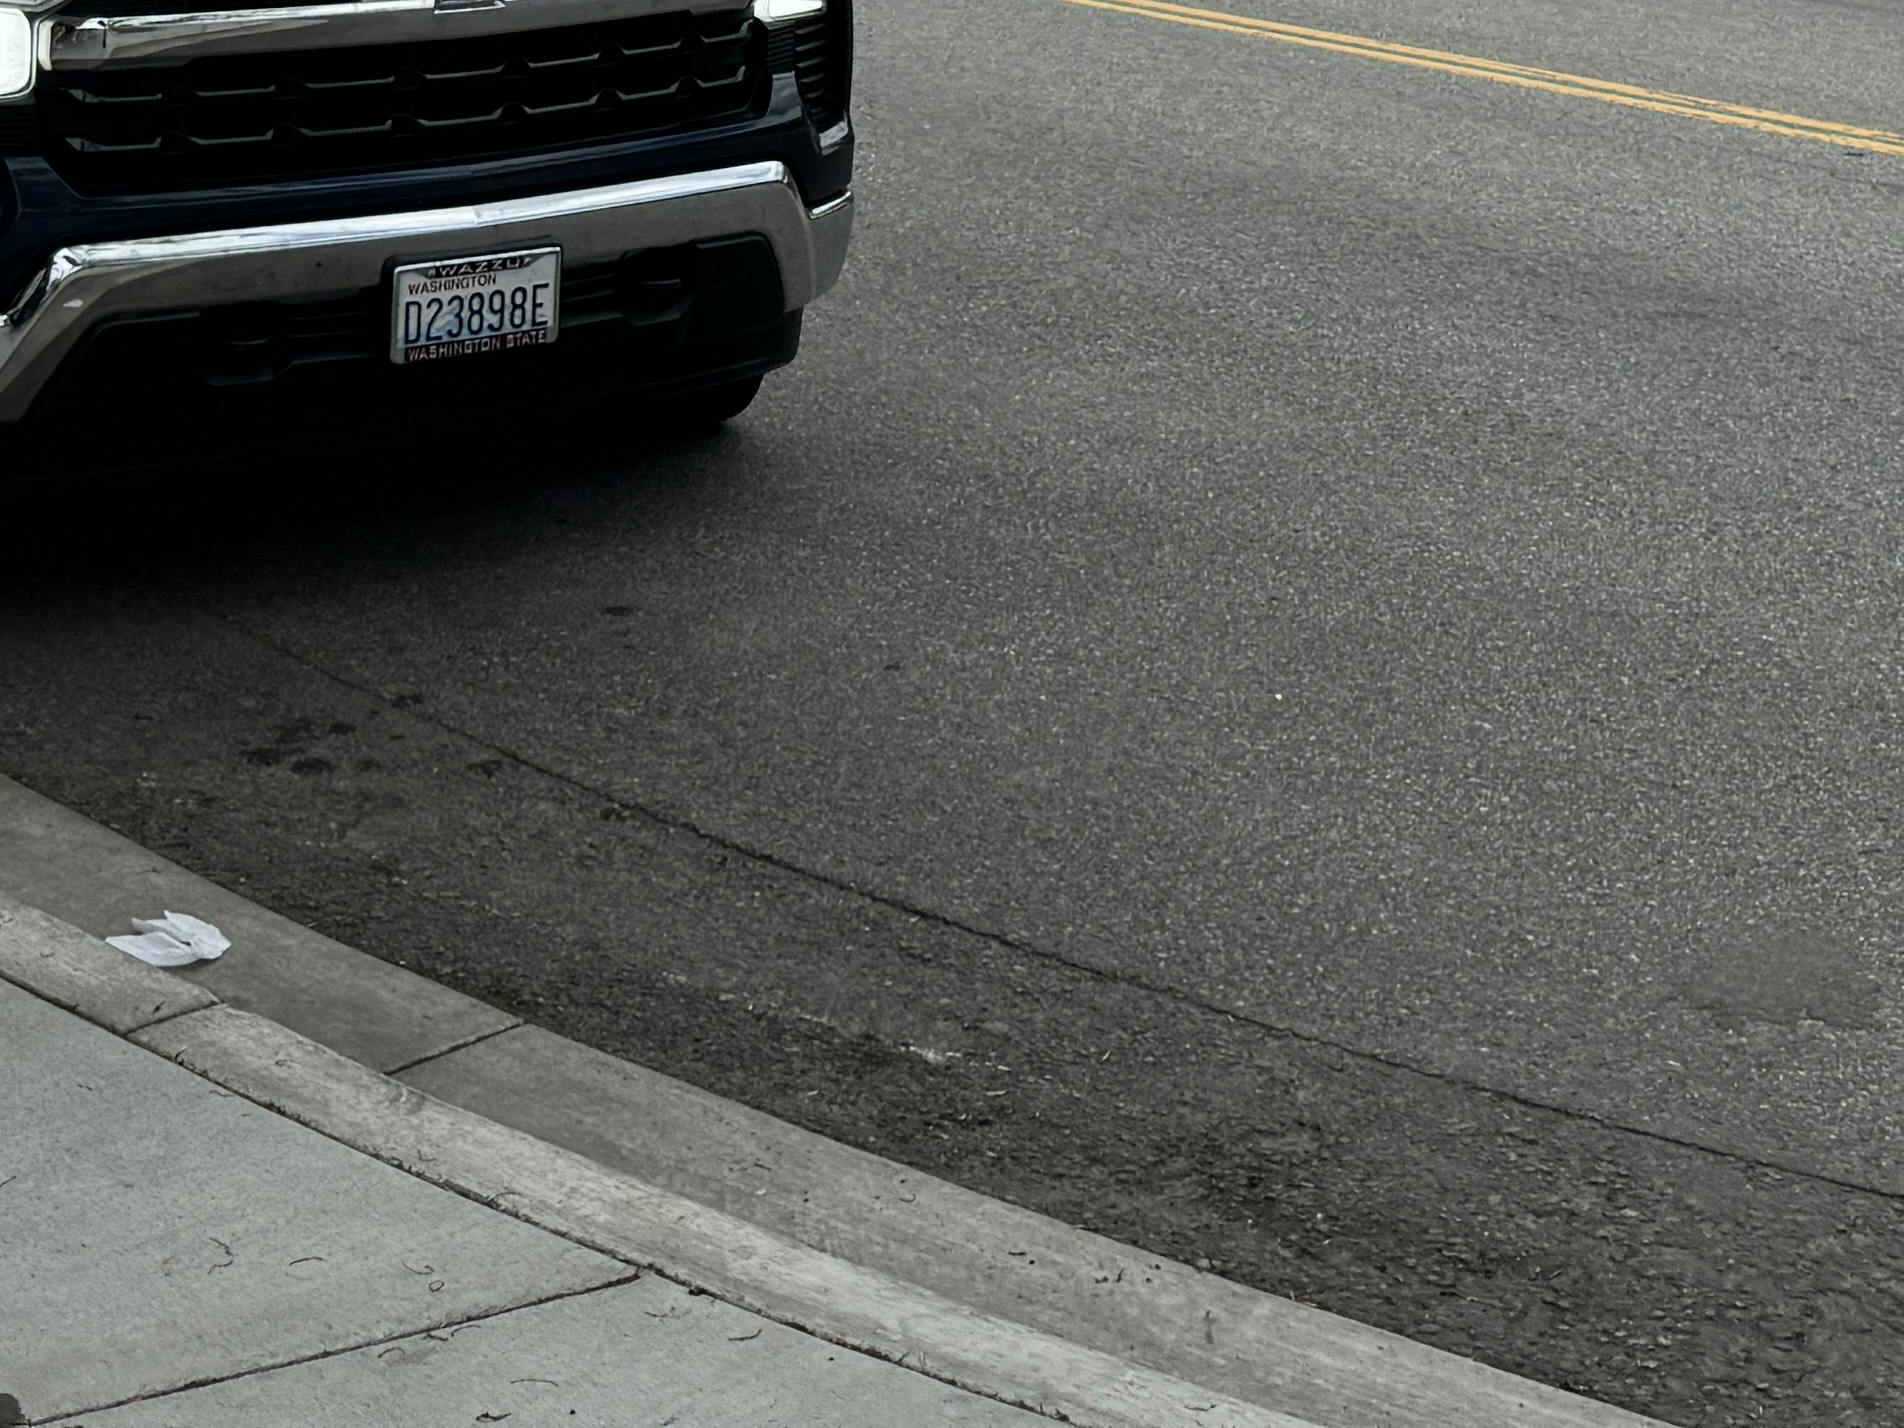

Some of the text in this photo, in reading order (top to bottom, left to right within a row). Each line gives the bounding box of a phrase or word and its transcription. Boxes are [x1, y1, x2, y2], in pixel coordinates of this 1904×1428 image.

[440, 257, 521, 276] WAZZU
[408, 273, 496, 295] WASHINGTON
[404, 283, 550, 344] D23898E
[408, 330, 546, 361] WASHINGTON STATE
